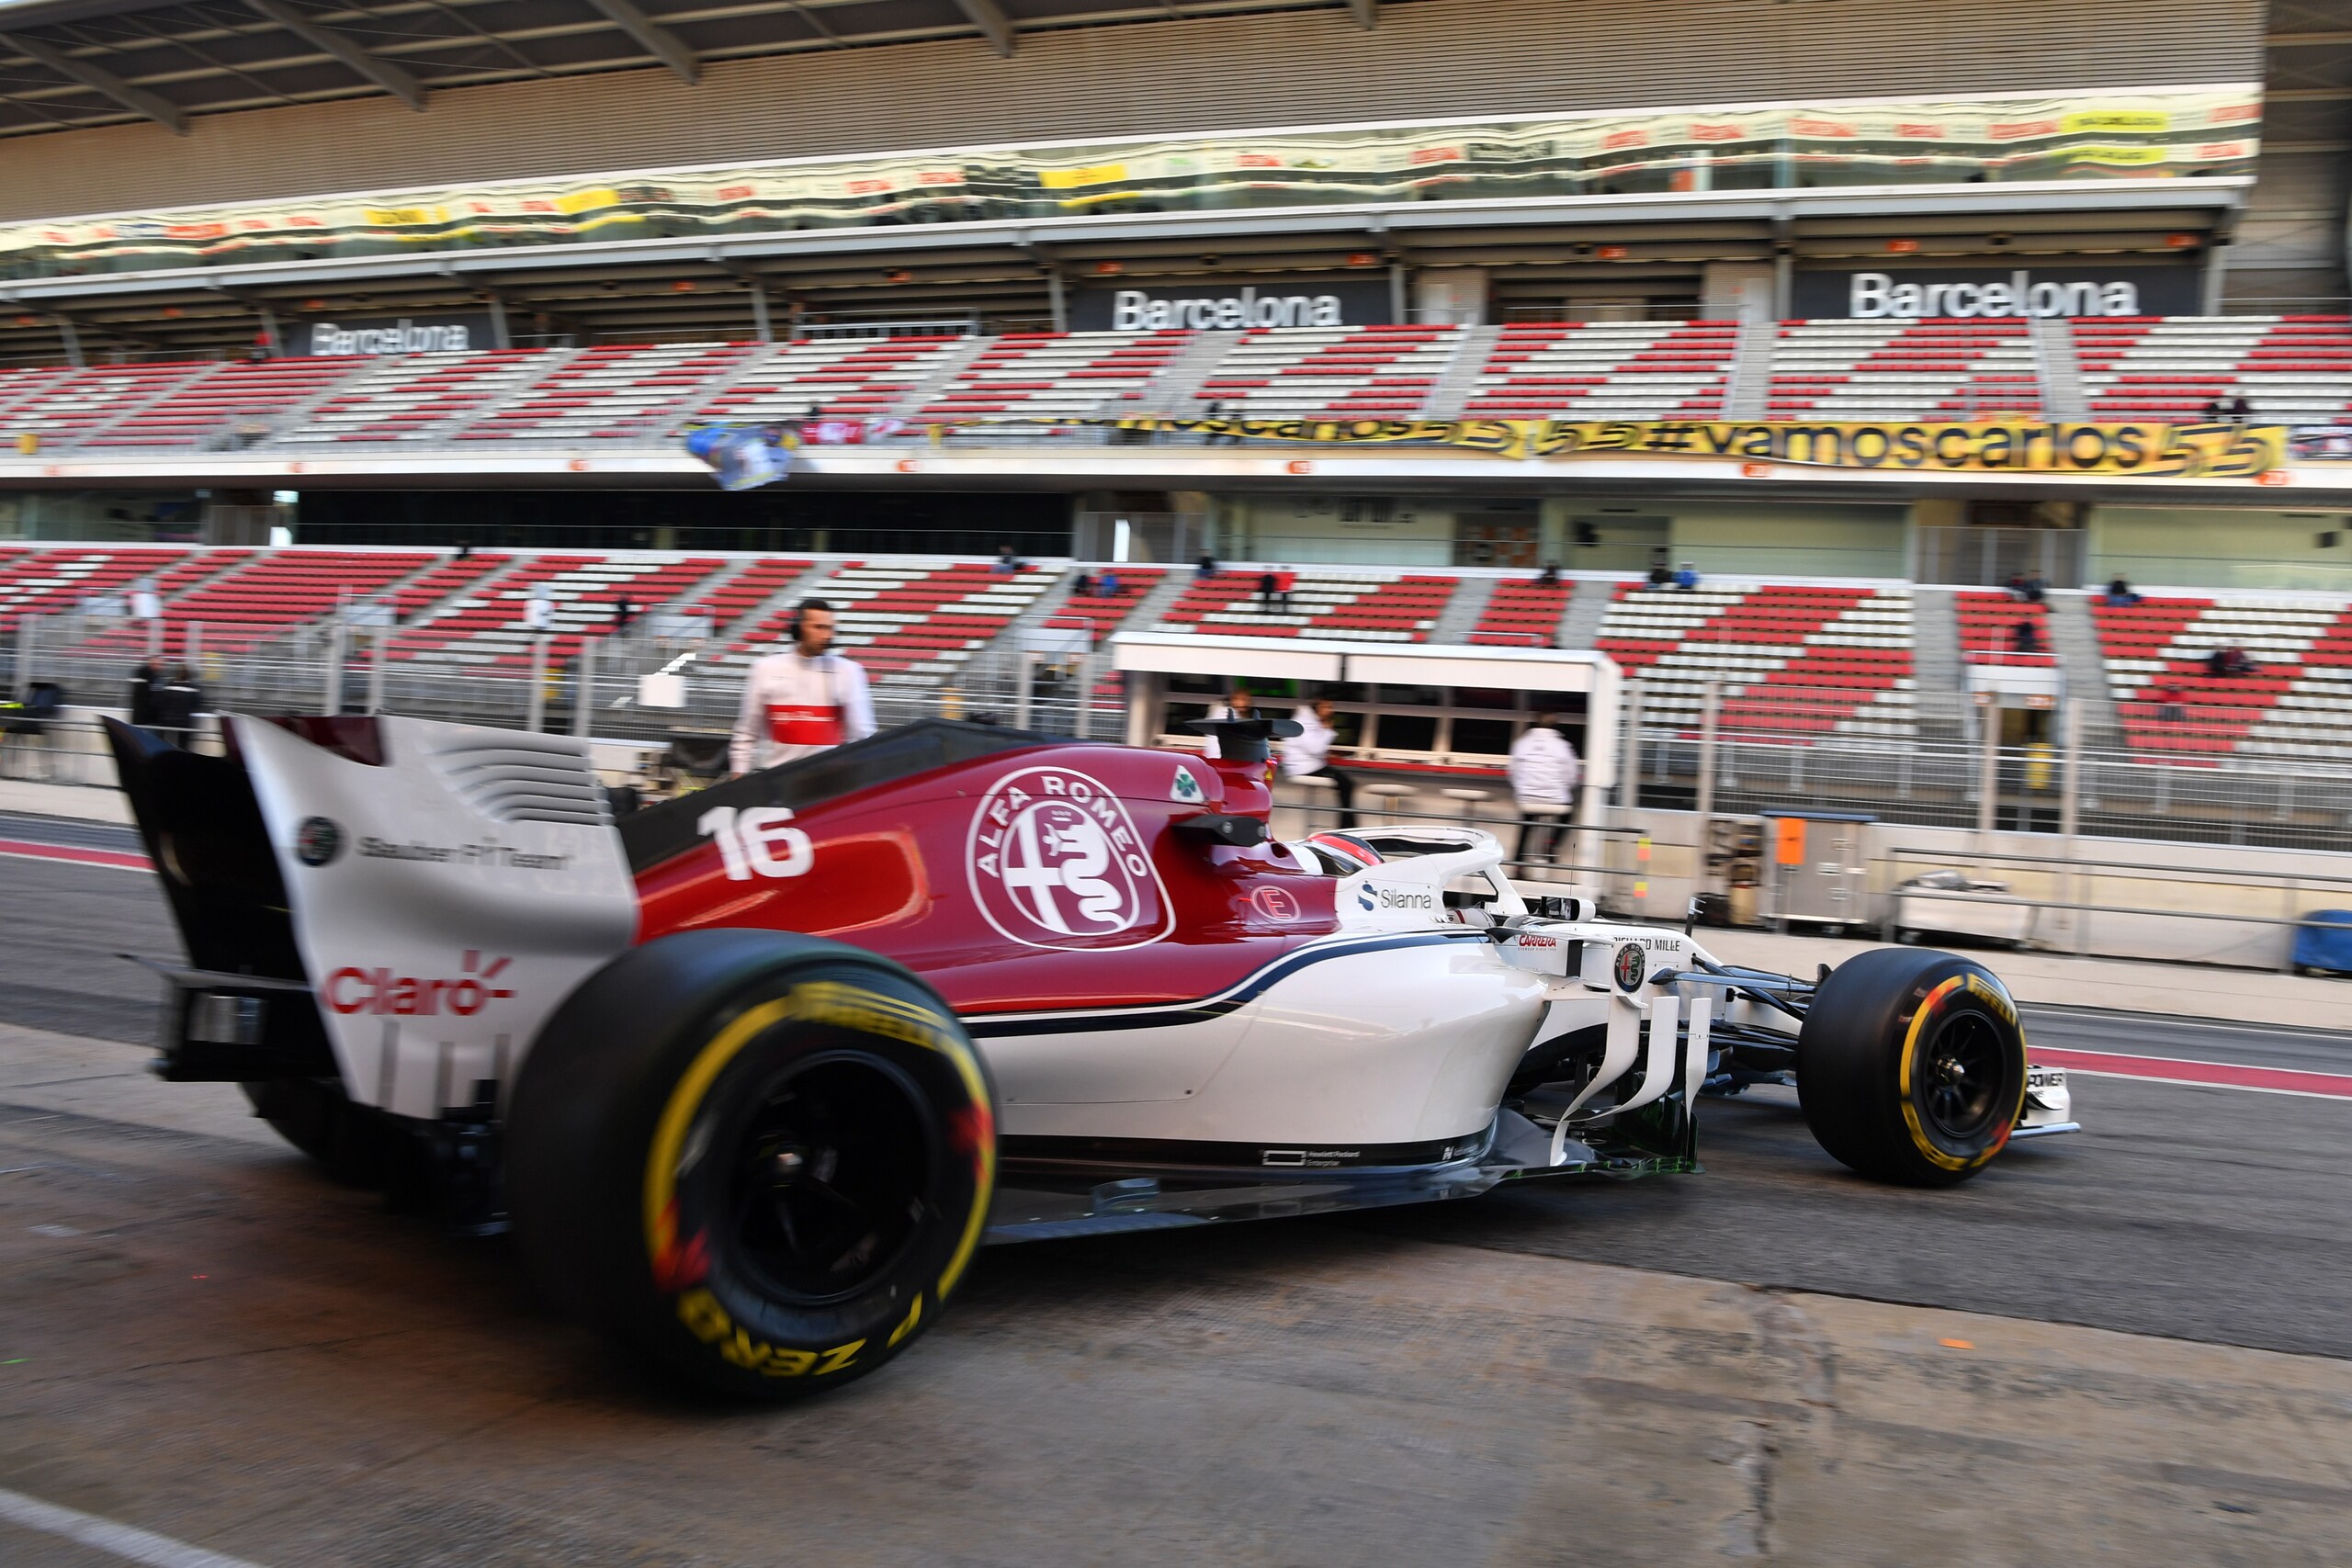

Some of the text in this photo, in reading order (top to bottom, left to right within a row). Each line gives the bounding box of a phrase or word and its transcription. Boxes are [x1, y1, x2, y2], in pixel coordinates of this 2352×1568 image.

[1113, 287, 1342, 331] Barcelona
[1849, 270, 2141, 318] Barcelona
[309, 319, 469, 355] Barcelona
[696, 806, 816, 881] 16
[977, 775, 1148, 878] ALFA ROMEO
[1380, 888, 1431, 909] Silanna
[1519, 934, 1556, 947] CARRERA
[1615, 947, 1629, 967] ALFA
[1654, 939, 1680, 952] MILLE
[323, 966, 488, 1016] Claro
[677, 1288, 867, 1378] ZERO
